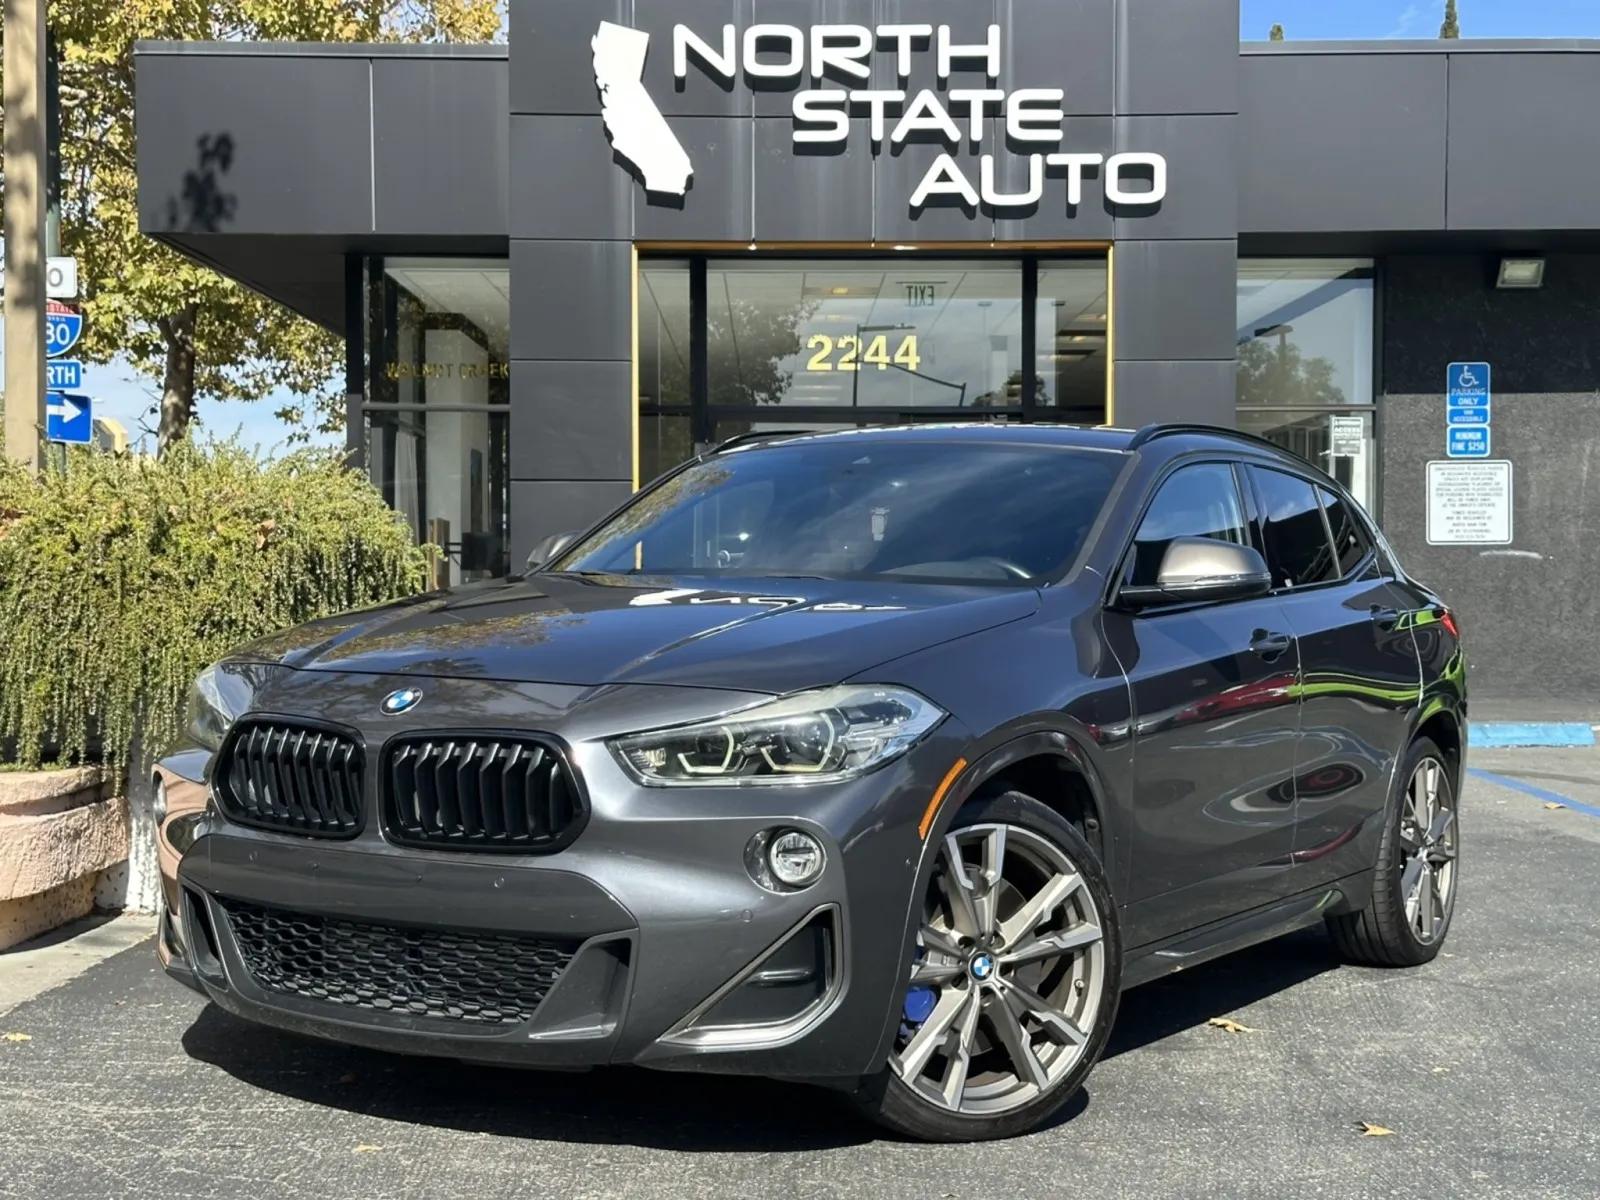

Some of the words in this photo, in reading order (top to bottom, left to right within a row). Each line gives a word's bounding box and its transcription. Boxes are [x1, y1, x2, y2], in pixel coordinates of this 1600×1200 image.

[673, 24, 1000, 78] NORTH
[792, 89, 1064, 142] STATE
[909, 152, 1167, 206] AUTO
[48, 267, 63, 287] O
[806, 333, 921, 371] 2244
[46, 365, 76, 385] RTH
[1451, 387, 1486, 396] PARKING
[1457, 397, 1479, 405] ONLY
[1451, 441, 1465, 451] FINE
